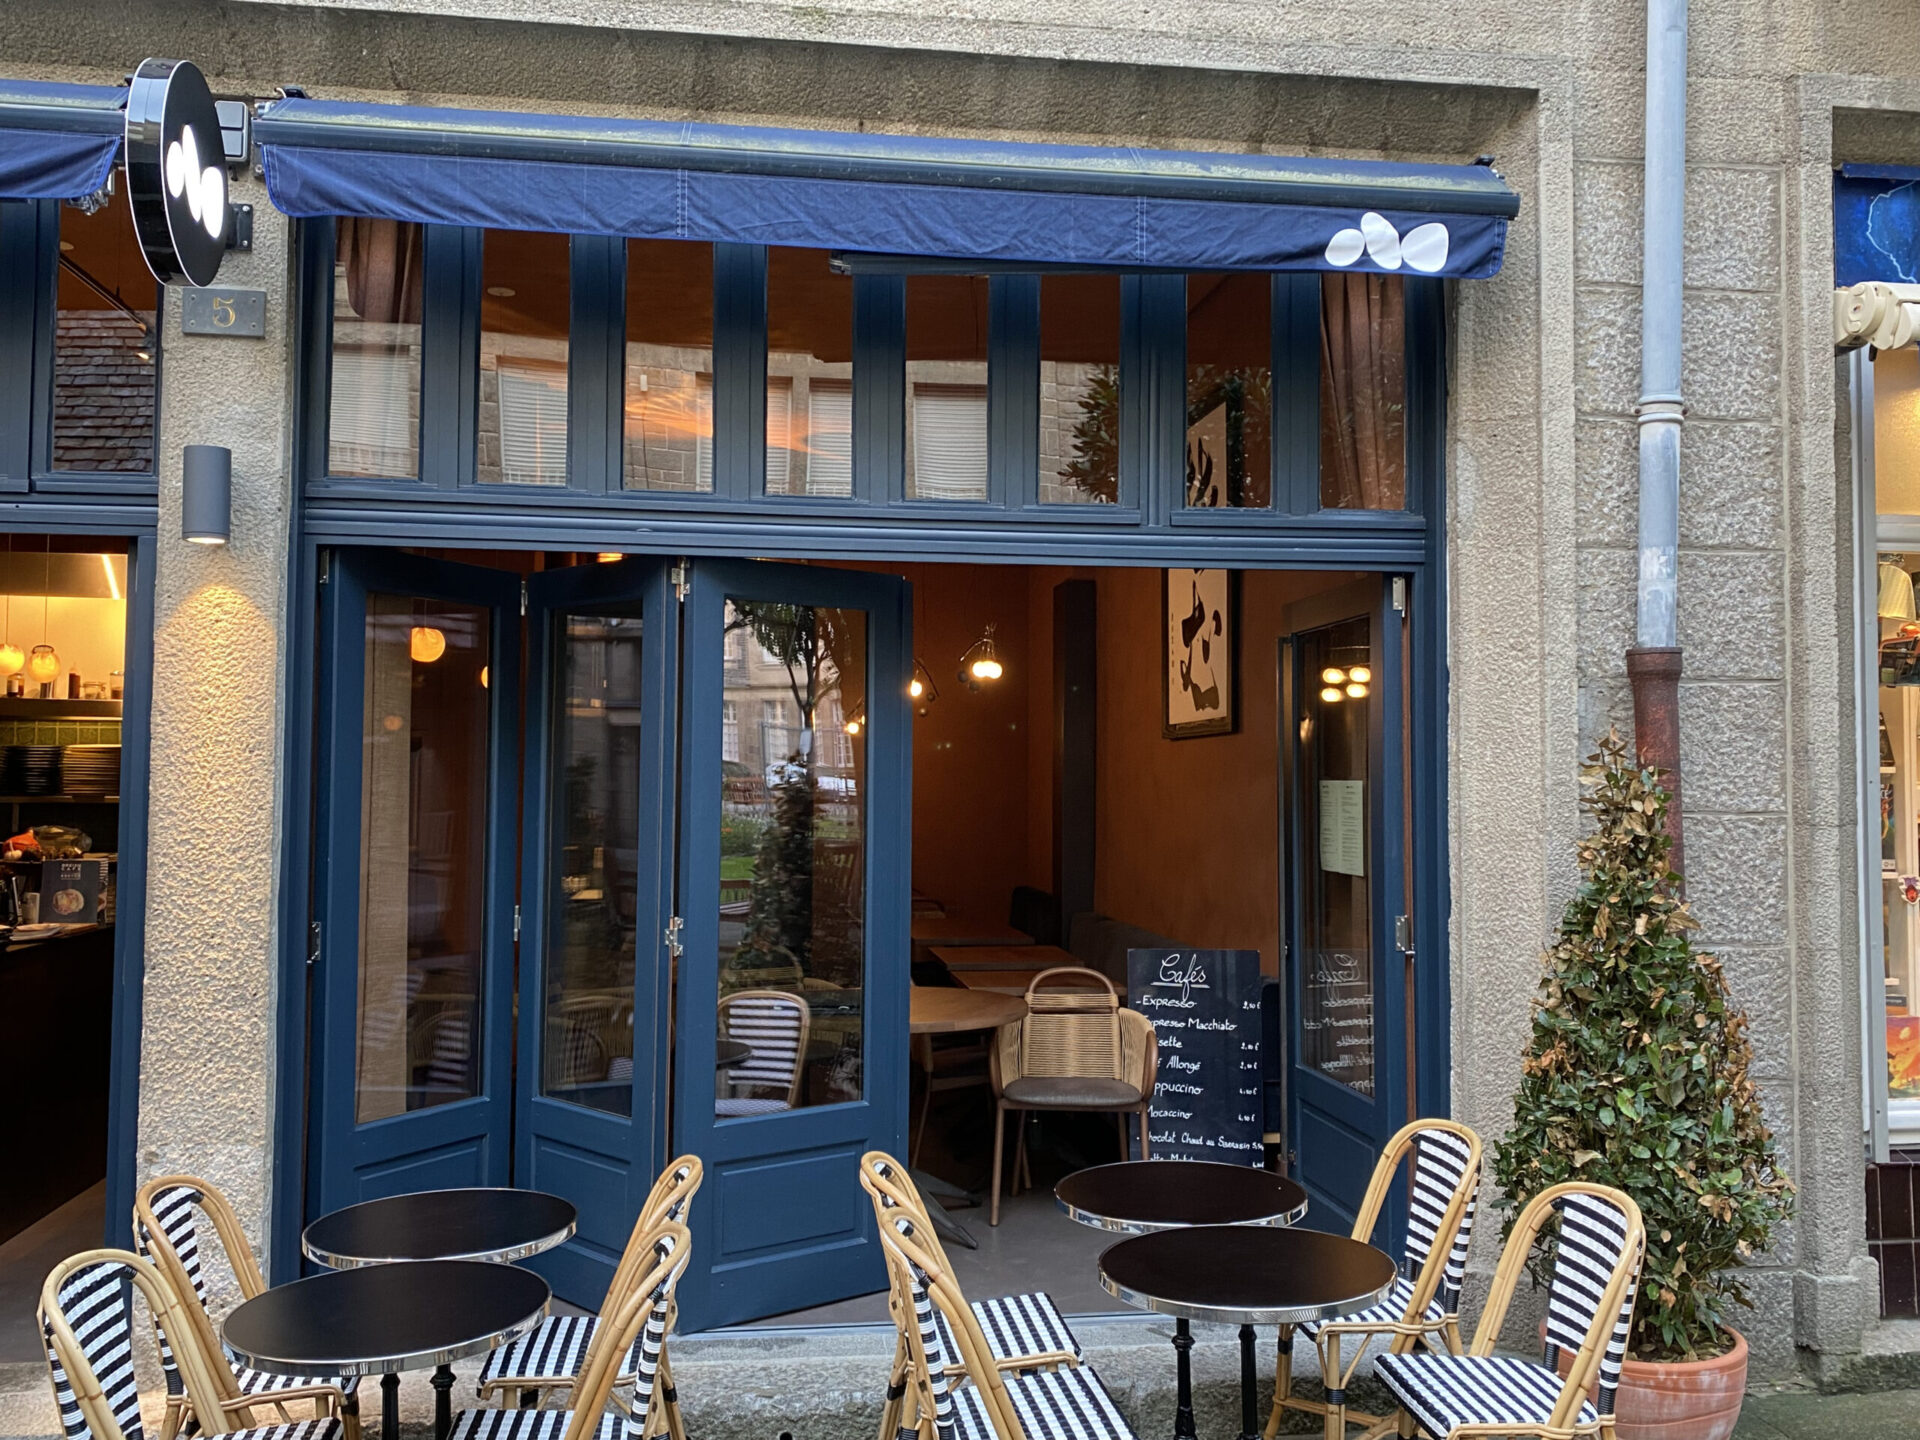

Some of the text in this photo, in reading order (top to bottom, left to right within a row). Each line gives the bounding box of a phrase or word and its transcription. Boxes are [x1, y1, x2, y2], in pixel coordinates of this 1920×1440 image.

[213, 297, 236, 328] 5
[1159, 953, 1207, 1000] Cafés
[1142, 995, 1197, 1010] Expresso
[1146, 1017, 1238, 1031] presso Macchiato
[1157, 1035, 1183, 1048] sette
[1165, 1055, 1202, 1074] Allongé
[1153, 1082, 1204, 1097] ppuccino
[1148, 1130, 1177, 1143] hocolat
